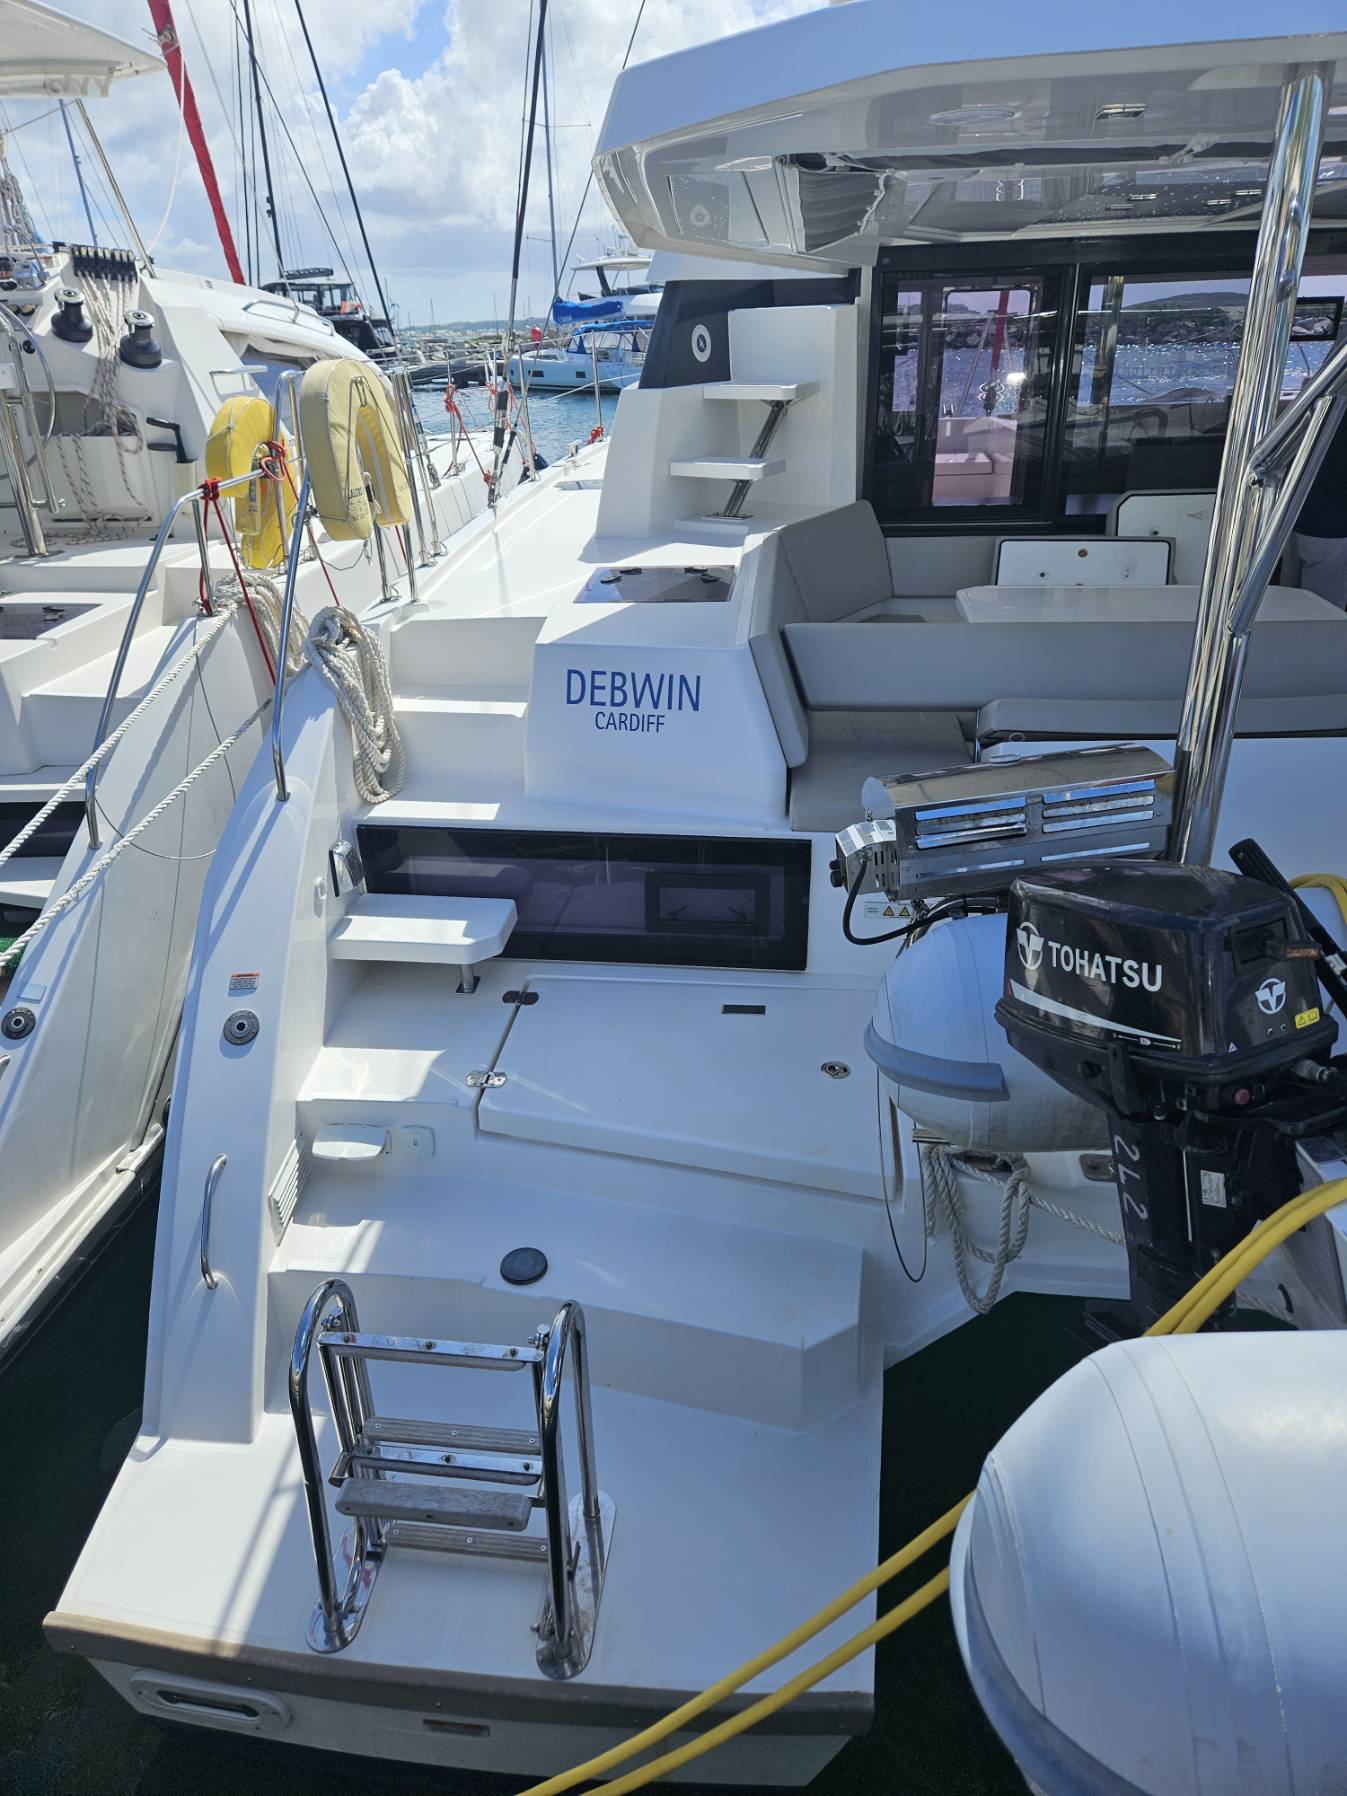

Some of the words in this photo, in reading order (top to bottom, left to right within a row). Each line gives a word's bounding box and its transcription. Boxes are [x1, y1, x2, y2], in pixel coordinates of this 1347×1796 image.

[566, 669, 701, 711] DEBWIN
[595, 711, 665, 733] CARDIFF
[1048, 941, 1162, 992] TOHATSU
